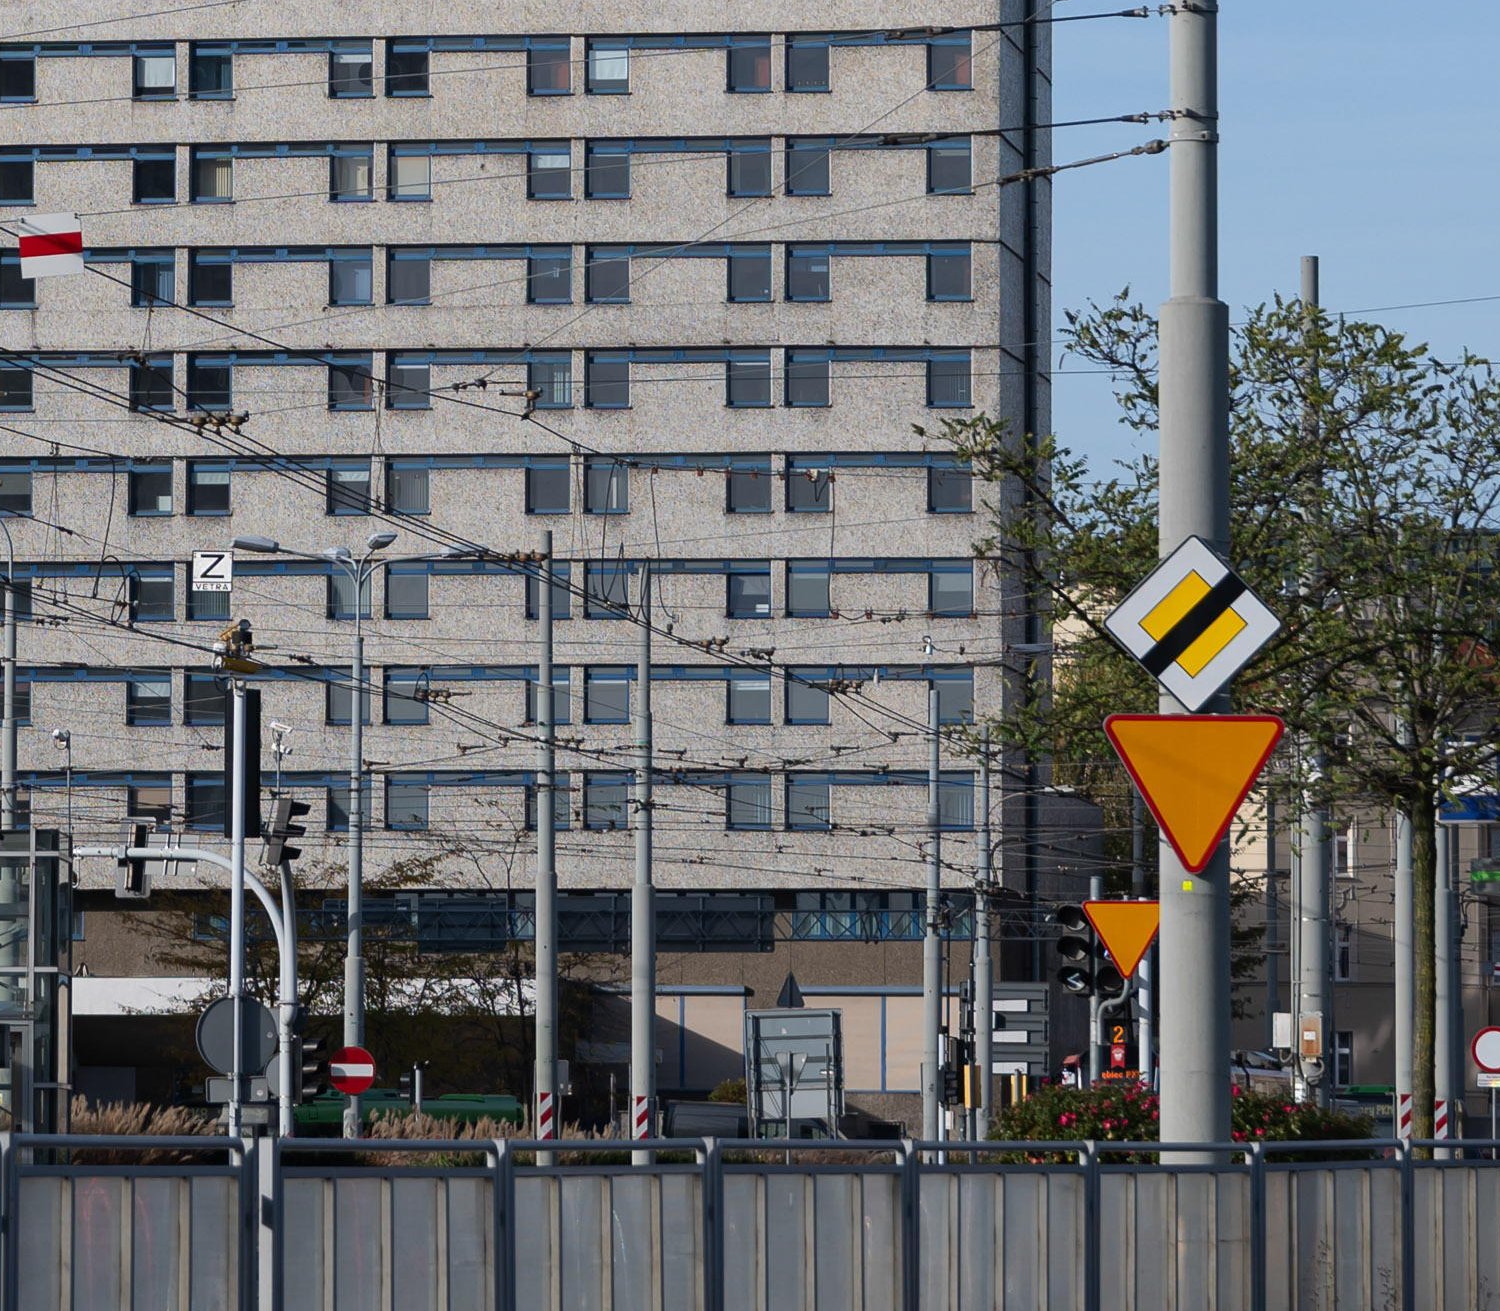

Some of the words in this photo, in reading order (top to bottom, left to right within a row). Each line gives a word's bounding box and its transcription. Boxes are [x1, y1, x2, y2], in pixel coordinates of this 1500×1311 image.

[200, 554, 225, 578] Z
[195, 583, 229, 591] VETRA
[1113, 1025, 1124, 1043] 2
